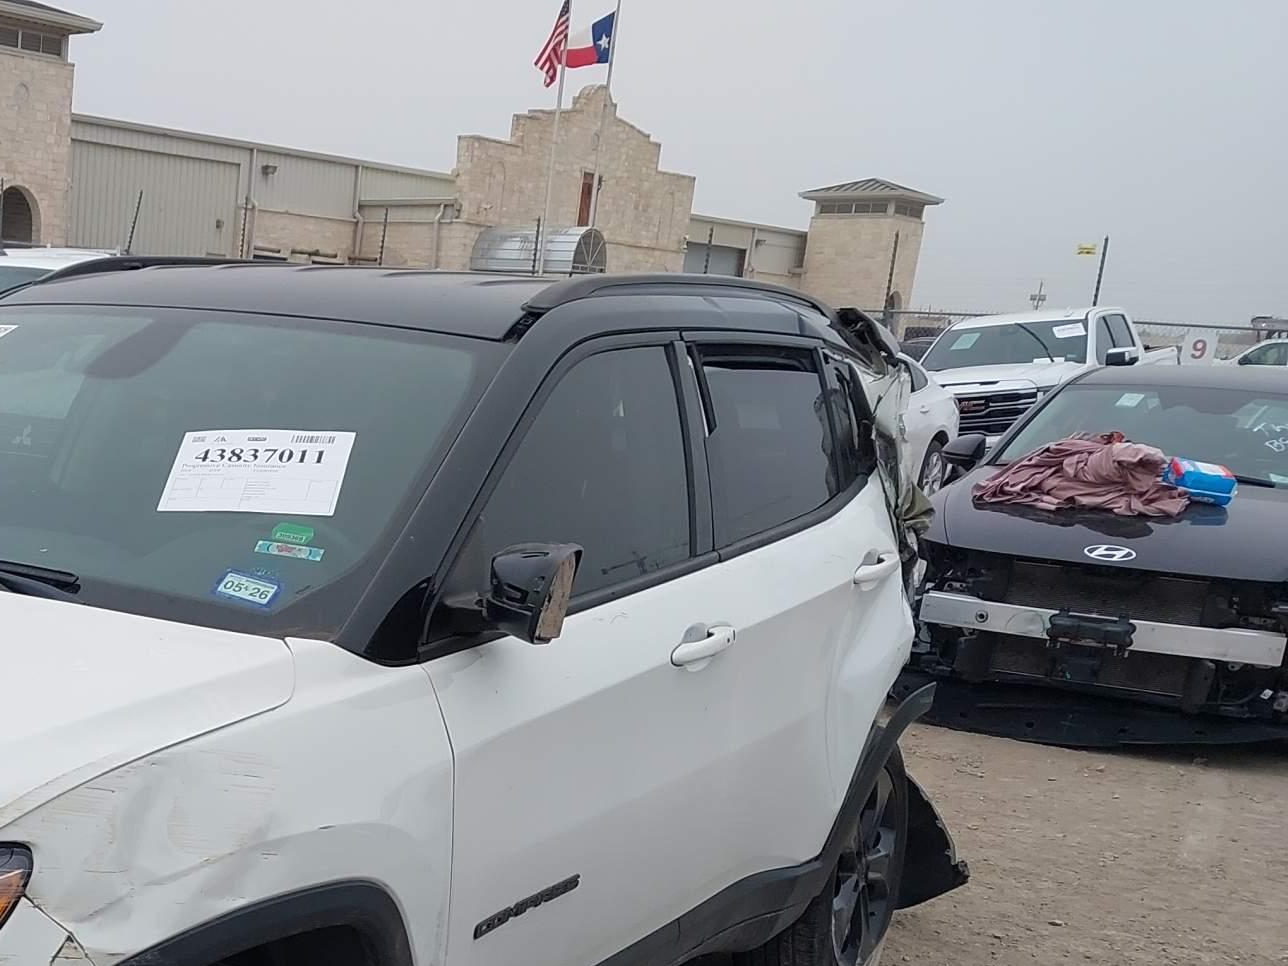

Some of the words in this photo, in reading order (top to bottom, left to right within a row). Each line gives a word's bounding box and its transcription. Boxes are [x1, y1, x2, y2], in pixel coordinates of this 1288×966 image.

[1191, 339, 1207, 360] 9
[194, 447, 325, 464] 43837011
[223, 580, 245, 593] 05
[248, 586, 270, 600] 26
